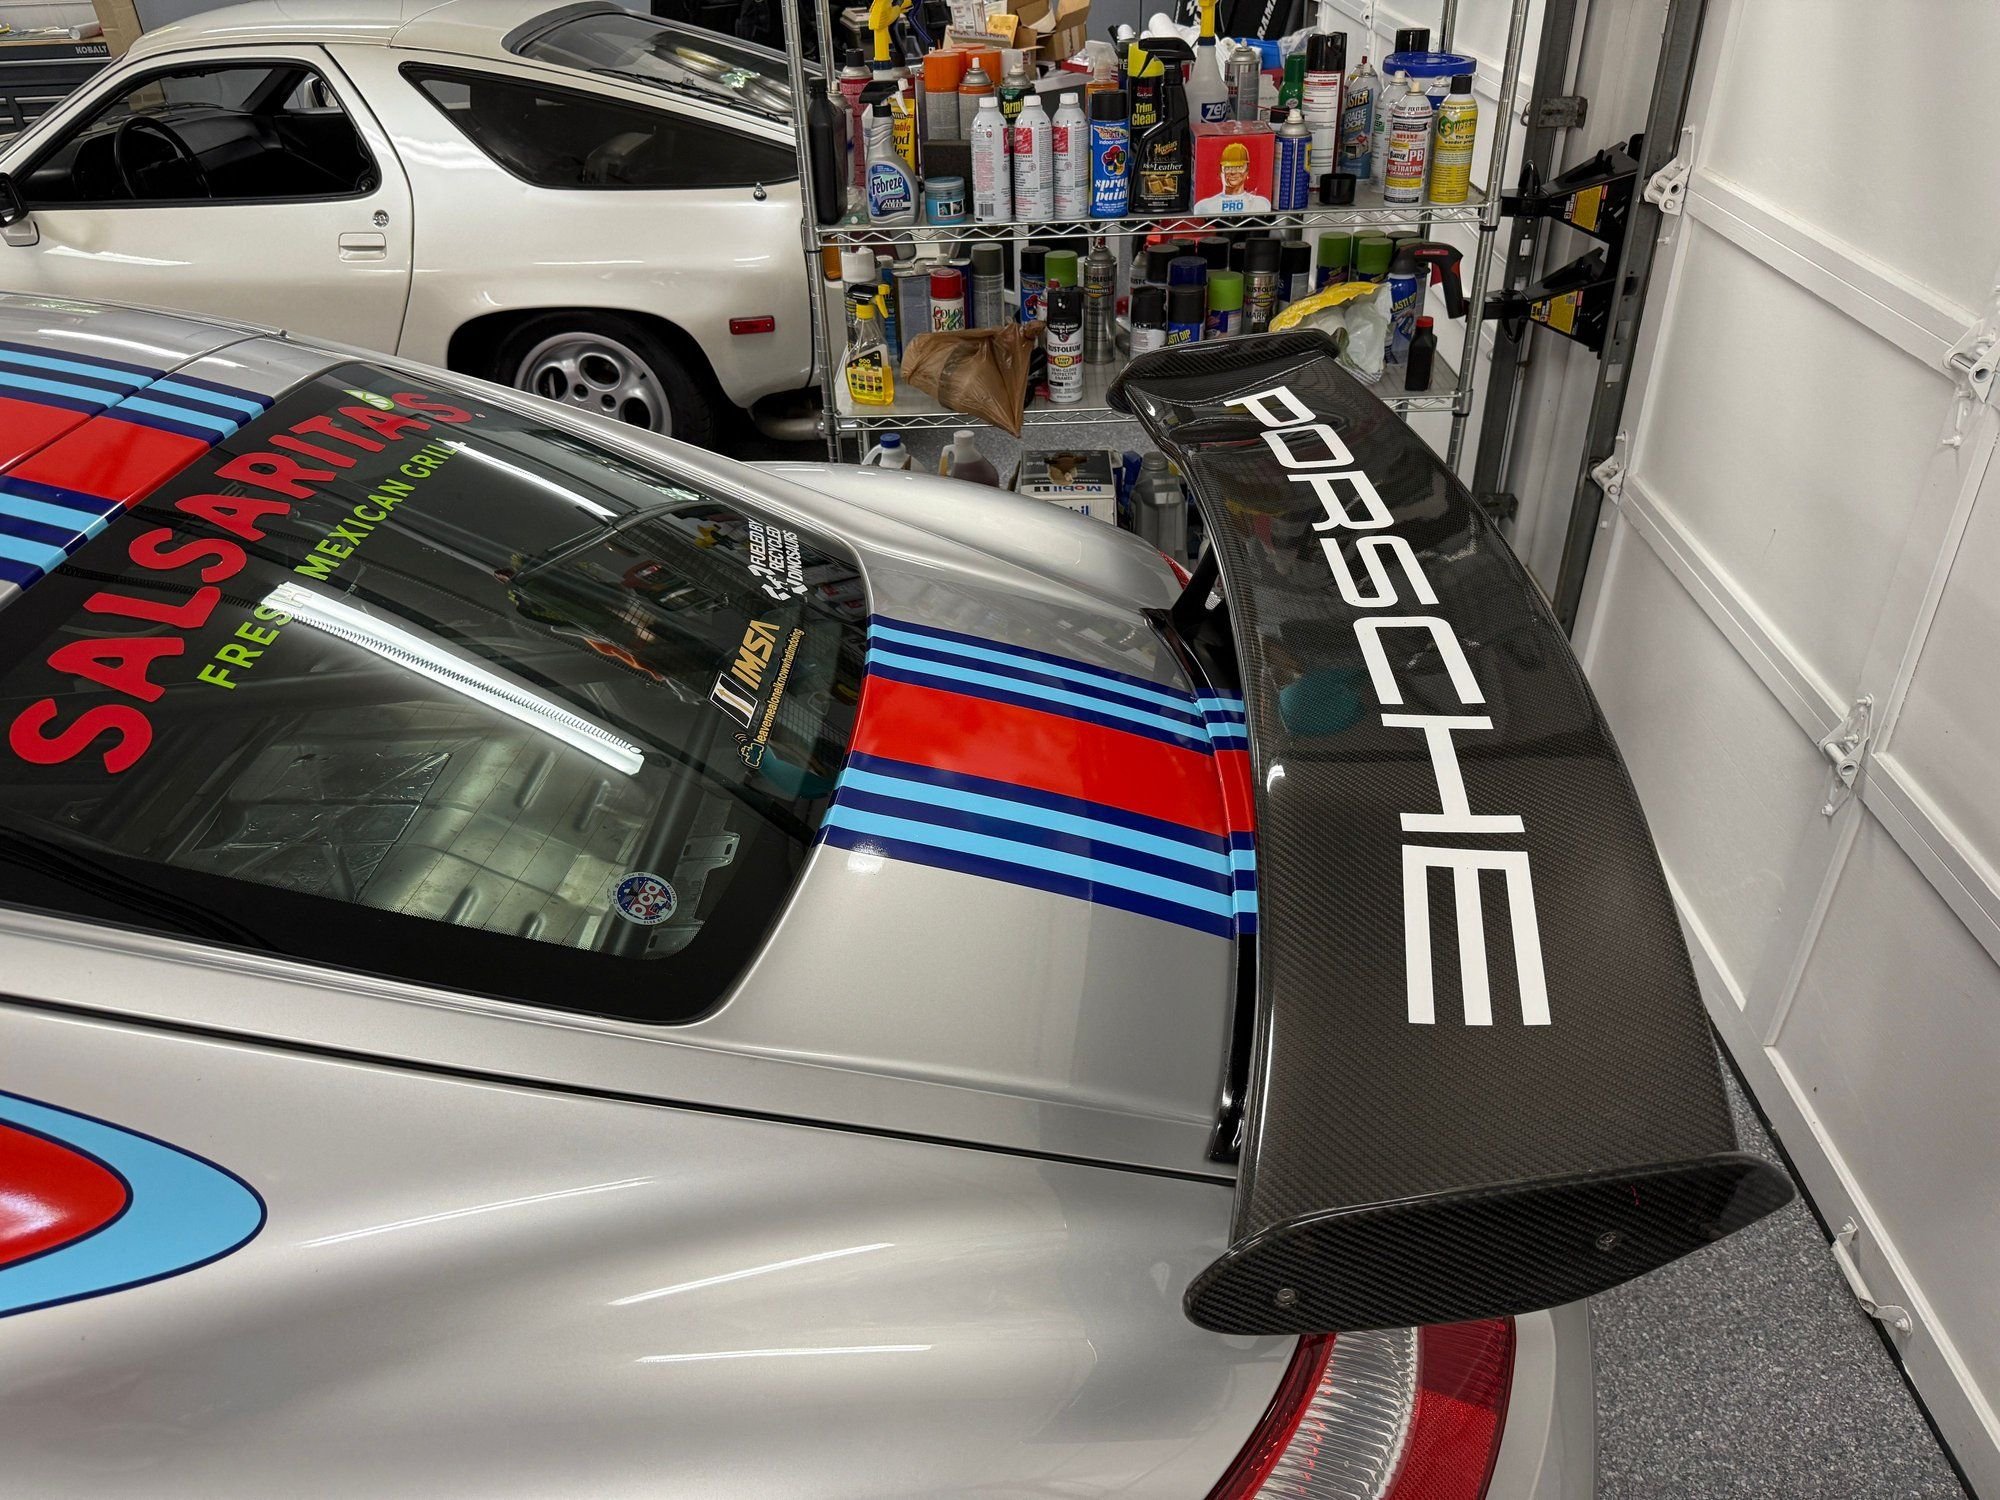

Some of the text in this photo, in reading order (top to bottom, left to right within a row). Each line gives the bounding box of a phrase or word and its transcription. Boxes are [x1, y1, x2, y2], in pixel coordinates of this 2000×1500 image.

[75, 45, 108, 55] KOBALT
[1131, 112, 1156, 126] Clean
[1135, 102, 1153, 113] Trim
[1153, 162, 1182, 171] Leather
[1409, 149, 1424, 161] PB
[872, 176, 903, 195] Febreze
[1222, 202, 1243, 212] PRO
[294, 477, 415, 581] MEXICAN
[750, 533, 766, 567] FUELED
[767, 526, 786, 572] RECYCLED
[782, 530, 803, 582] DINOSAURS
[9, 392, 472, 773] SALSARITAS
[731, 619, 780, 690] IMSA
[1224, 386, 1551, 1025] PORSCHE
